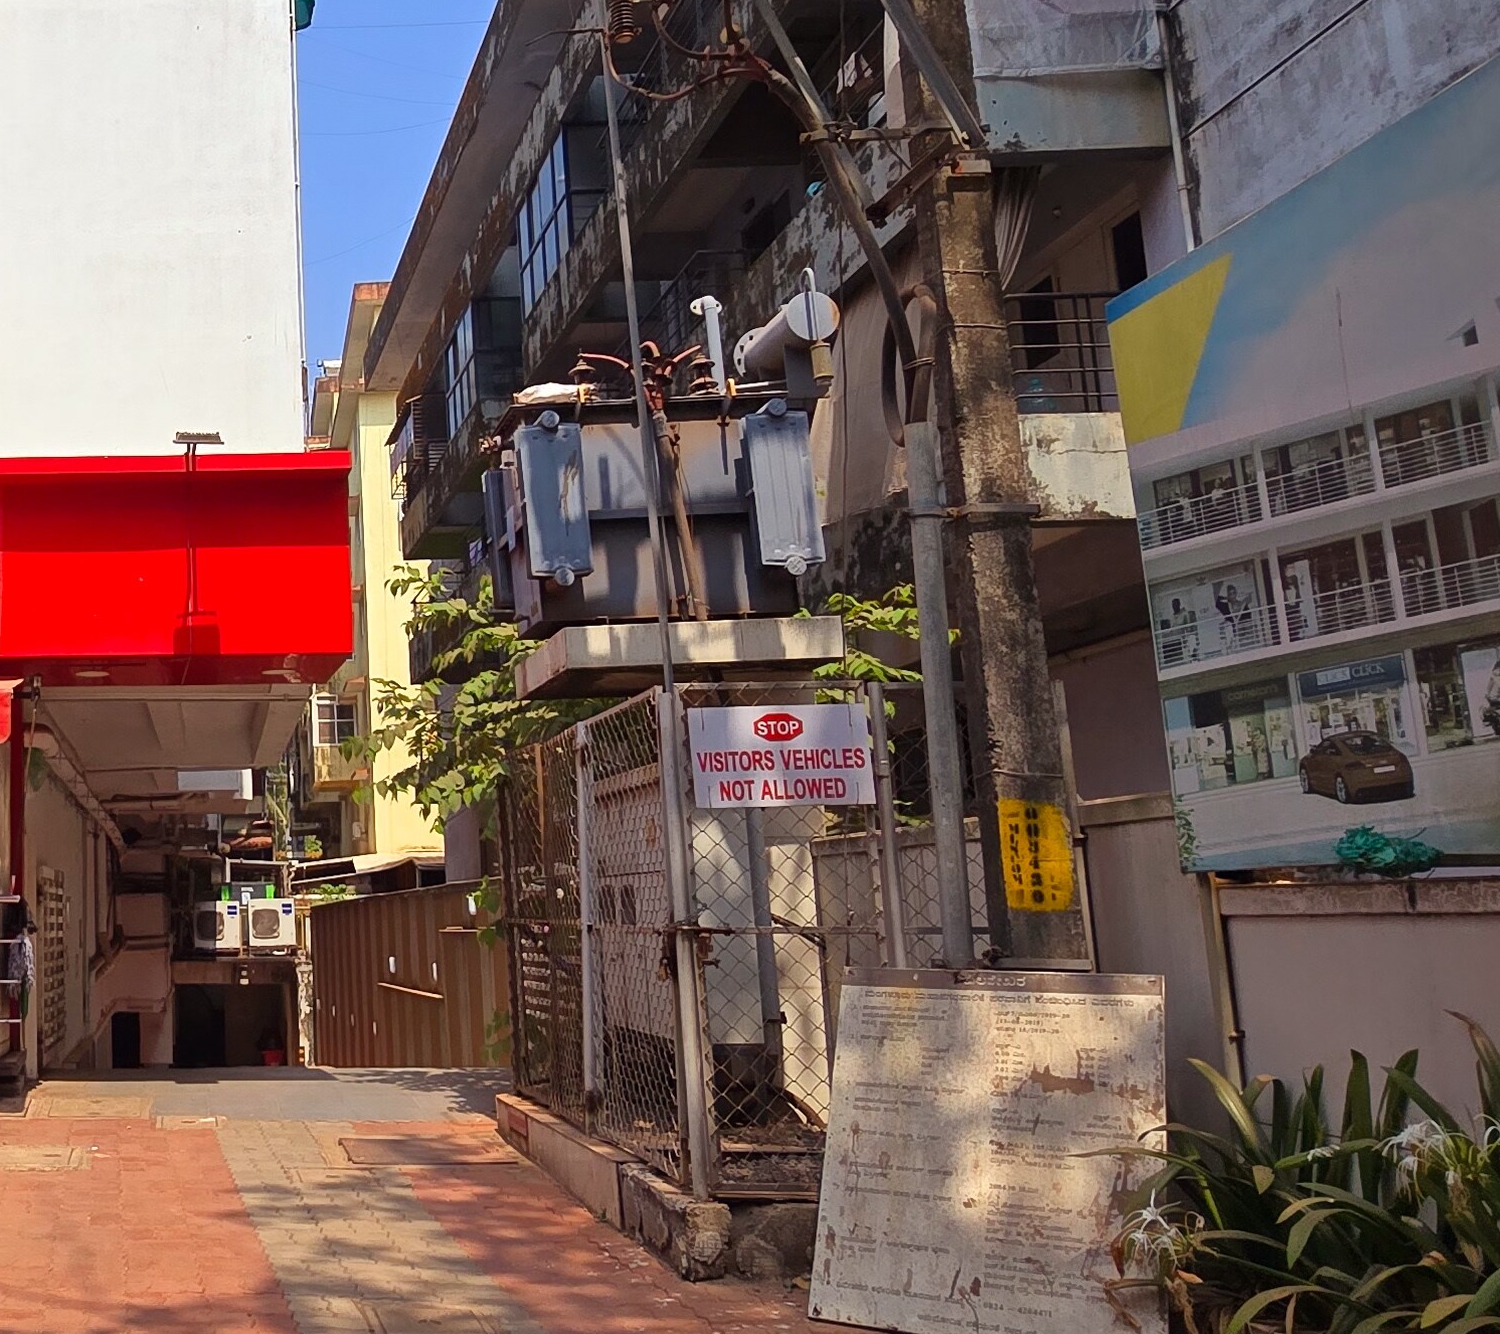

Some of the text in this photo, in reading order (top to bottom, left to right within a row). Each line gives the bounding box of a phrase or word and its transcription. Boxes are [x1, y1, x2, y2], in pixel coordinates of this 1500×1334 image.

[757, 720, 800, 736] STOP
[696, 748, 866, 773] VISITORS VEHICLES
[719, 777, 847, 802] NOT ALLOWED
